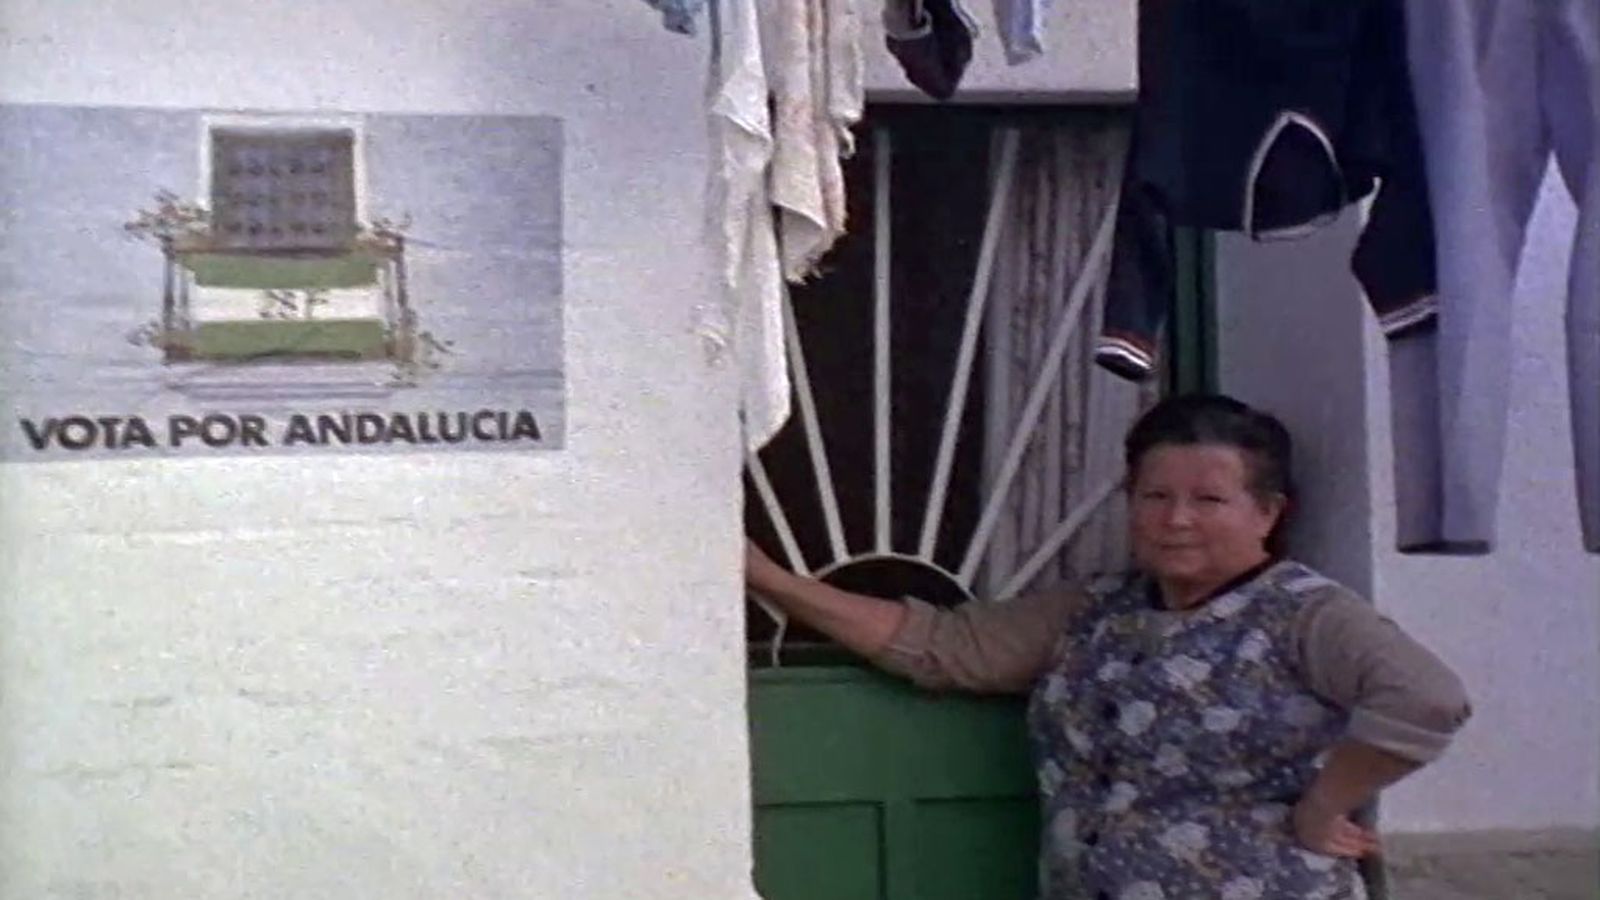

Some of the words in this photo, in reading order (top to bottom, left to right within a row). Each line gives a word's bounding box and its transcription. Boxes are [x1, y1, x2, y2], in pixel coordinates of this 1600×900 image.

[21, 416, 155, 450] VOTA
[169, 414, 269, 447] POR
[284, 411, 542, 446] ANDALUCIA
